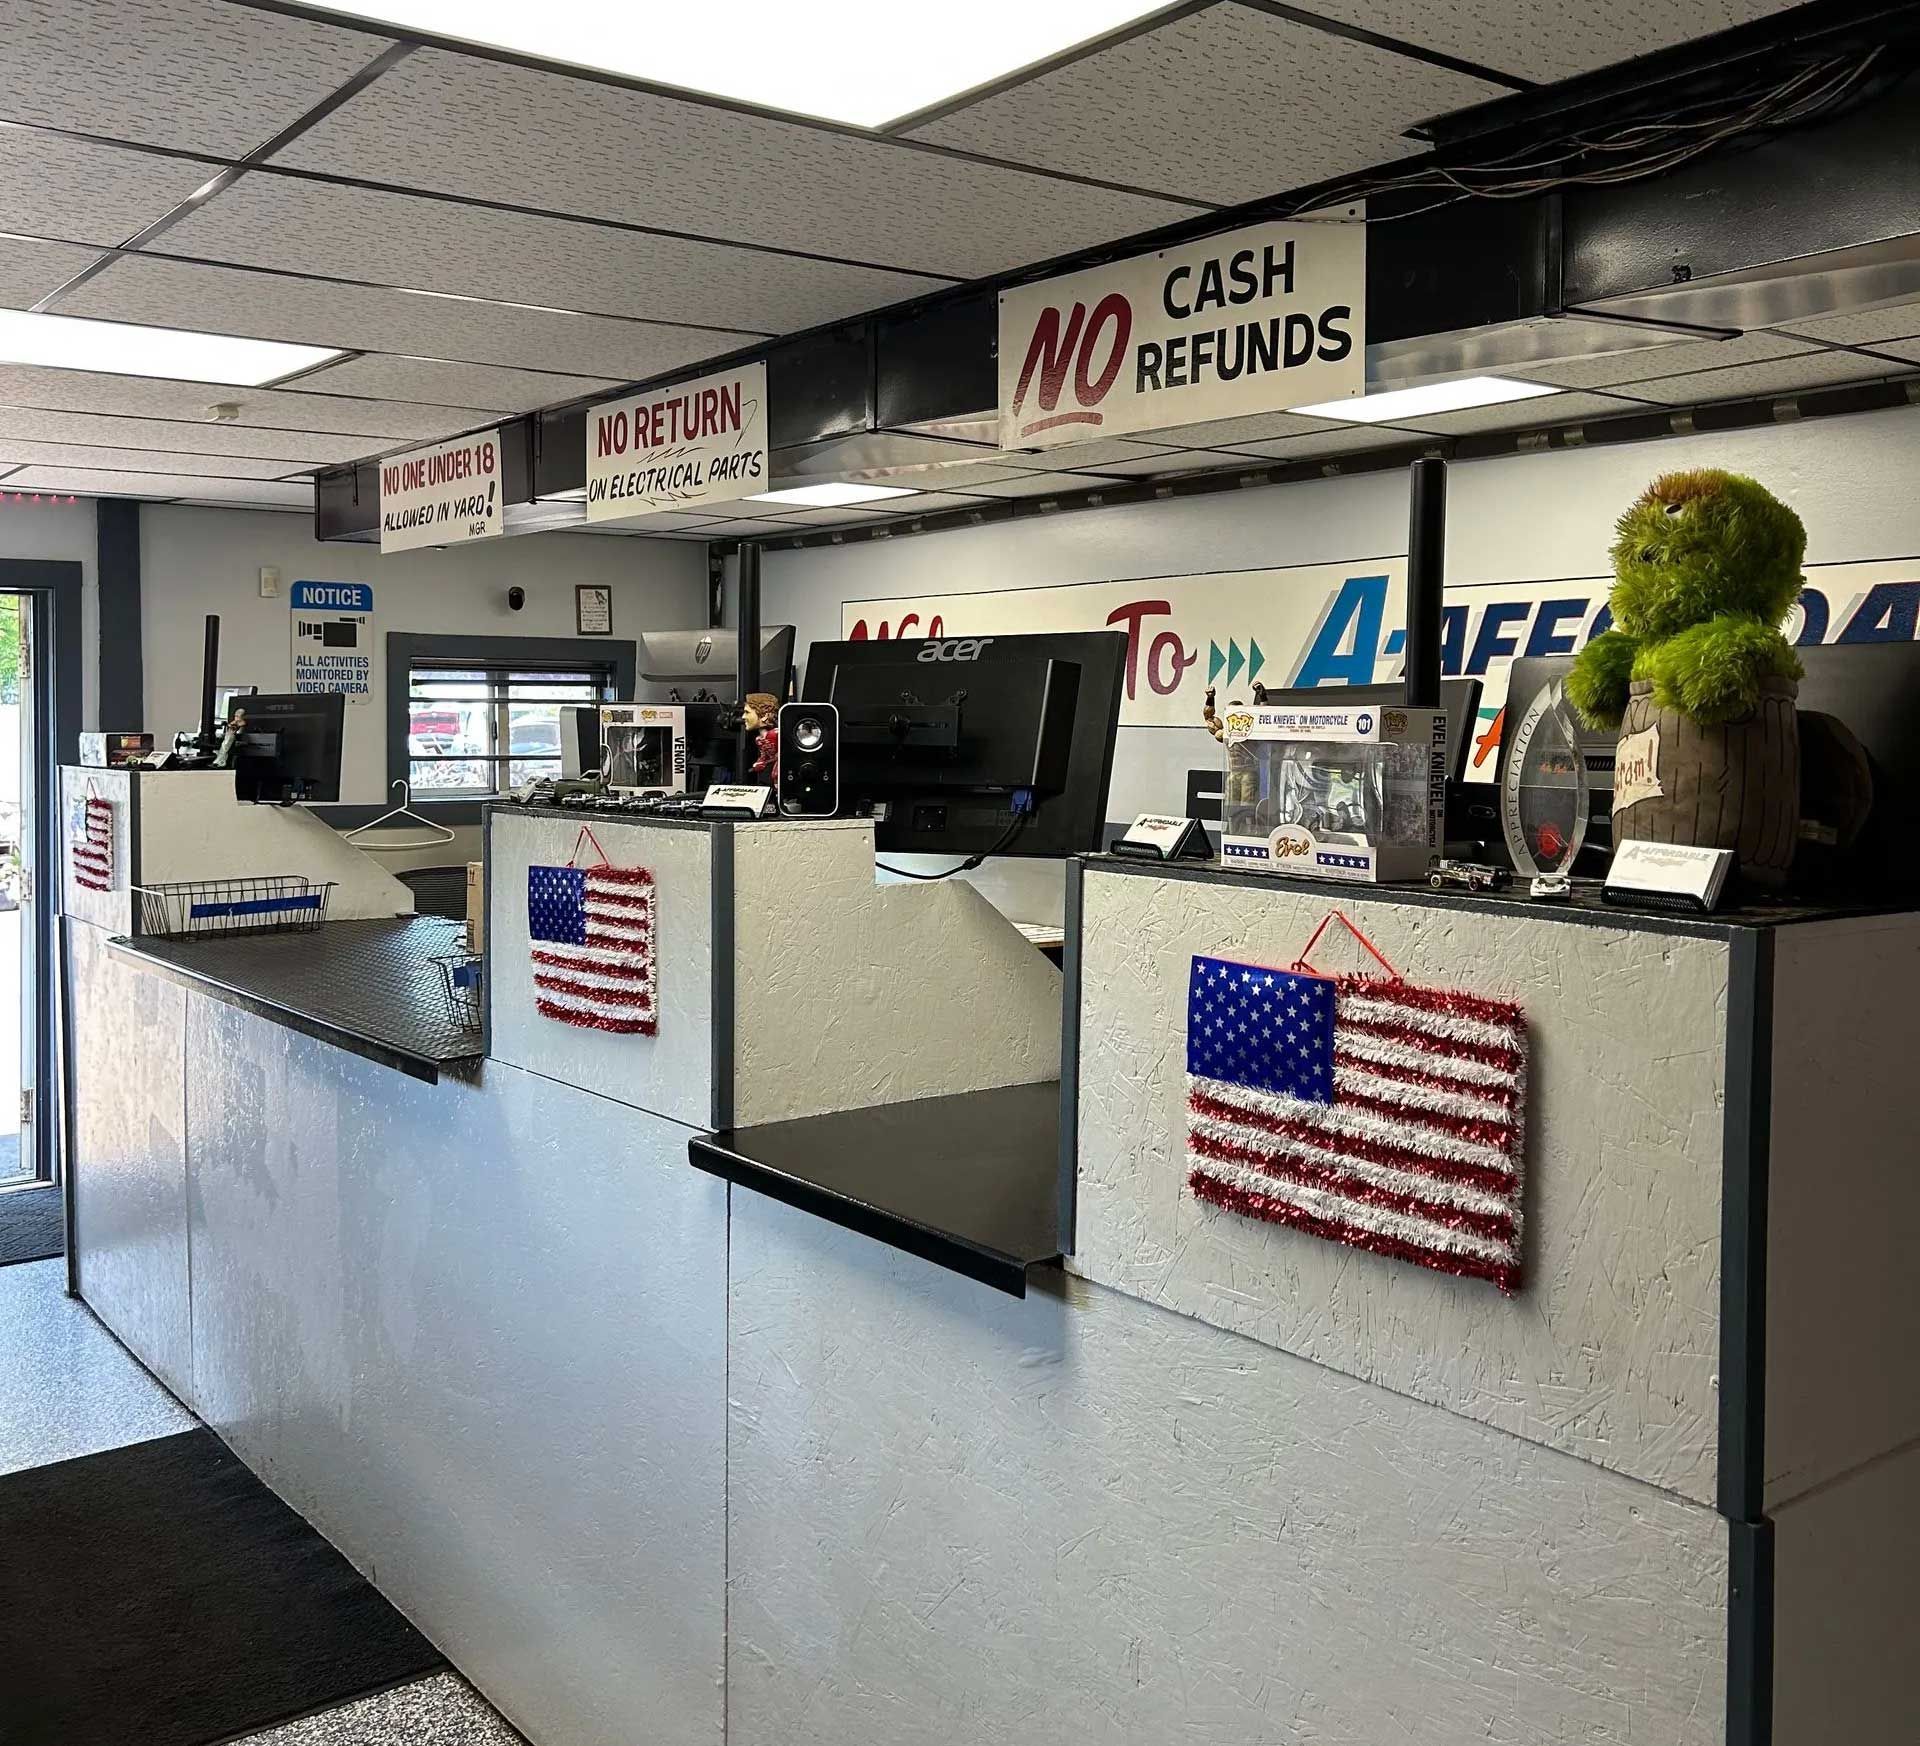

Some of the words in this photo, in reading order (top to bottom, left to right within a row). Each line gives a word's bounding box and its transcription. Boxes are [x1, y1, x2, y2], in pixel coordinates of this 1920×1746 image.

[1012, 292, 1132, 417] NO
[1163, 240, 1295, 320] CASH
[1135, 305, 1353, 394] REFUNDS
[598, 411, 628, 457] NO
[634, 382, 741, 450] RETURN
[384, 466, 400, 497] NO
[403, 459, 425, 492] ONE
[428, 448, 472, 486] UNDER
[475, 442, 495, 475] 18
[589, 477, 607, 502] ON
[610, 461, 703, 499] ELECTRICAL
[708, 450, 763, 483] PARTS
[384, 504, 434, 532] ALLOWED
[437, 501, 450, 523] IN
[468, 521, 486, 536] MGR
[302, 588, 362, 606] NOTICE
[296, 655, 315, 667] ALL
[317, 655, 369, 668] ACTIVITIES
[917, 639, 994, 663] acer
[1105, 600, 1198, 701] To
[296, 669, 354, 681] MONITORED
[356, 669, 369, 681] BY
[296, 682, 326, 693] VIDEO
[328, 682, 369, 694] CAMERA
[1226, 712, 1254, 732] POP!
[1259, 714, 1272, 725] EVEL
[1299, 714, 1308, 725] ON
[1309, 714, 1348, 726] MOTORCYCLE
[1358, 718, 1372, 731] 101
[1432, 716, 1447, 748] EVEL
[674, 736, 685, 775] VENOM
[1430, 751, 1446, 806] KNIEVEL
[1508, 708, 1541, 856] APPRECIATION
